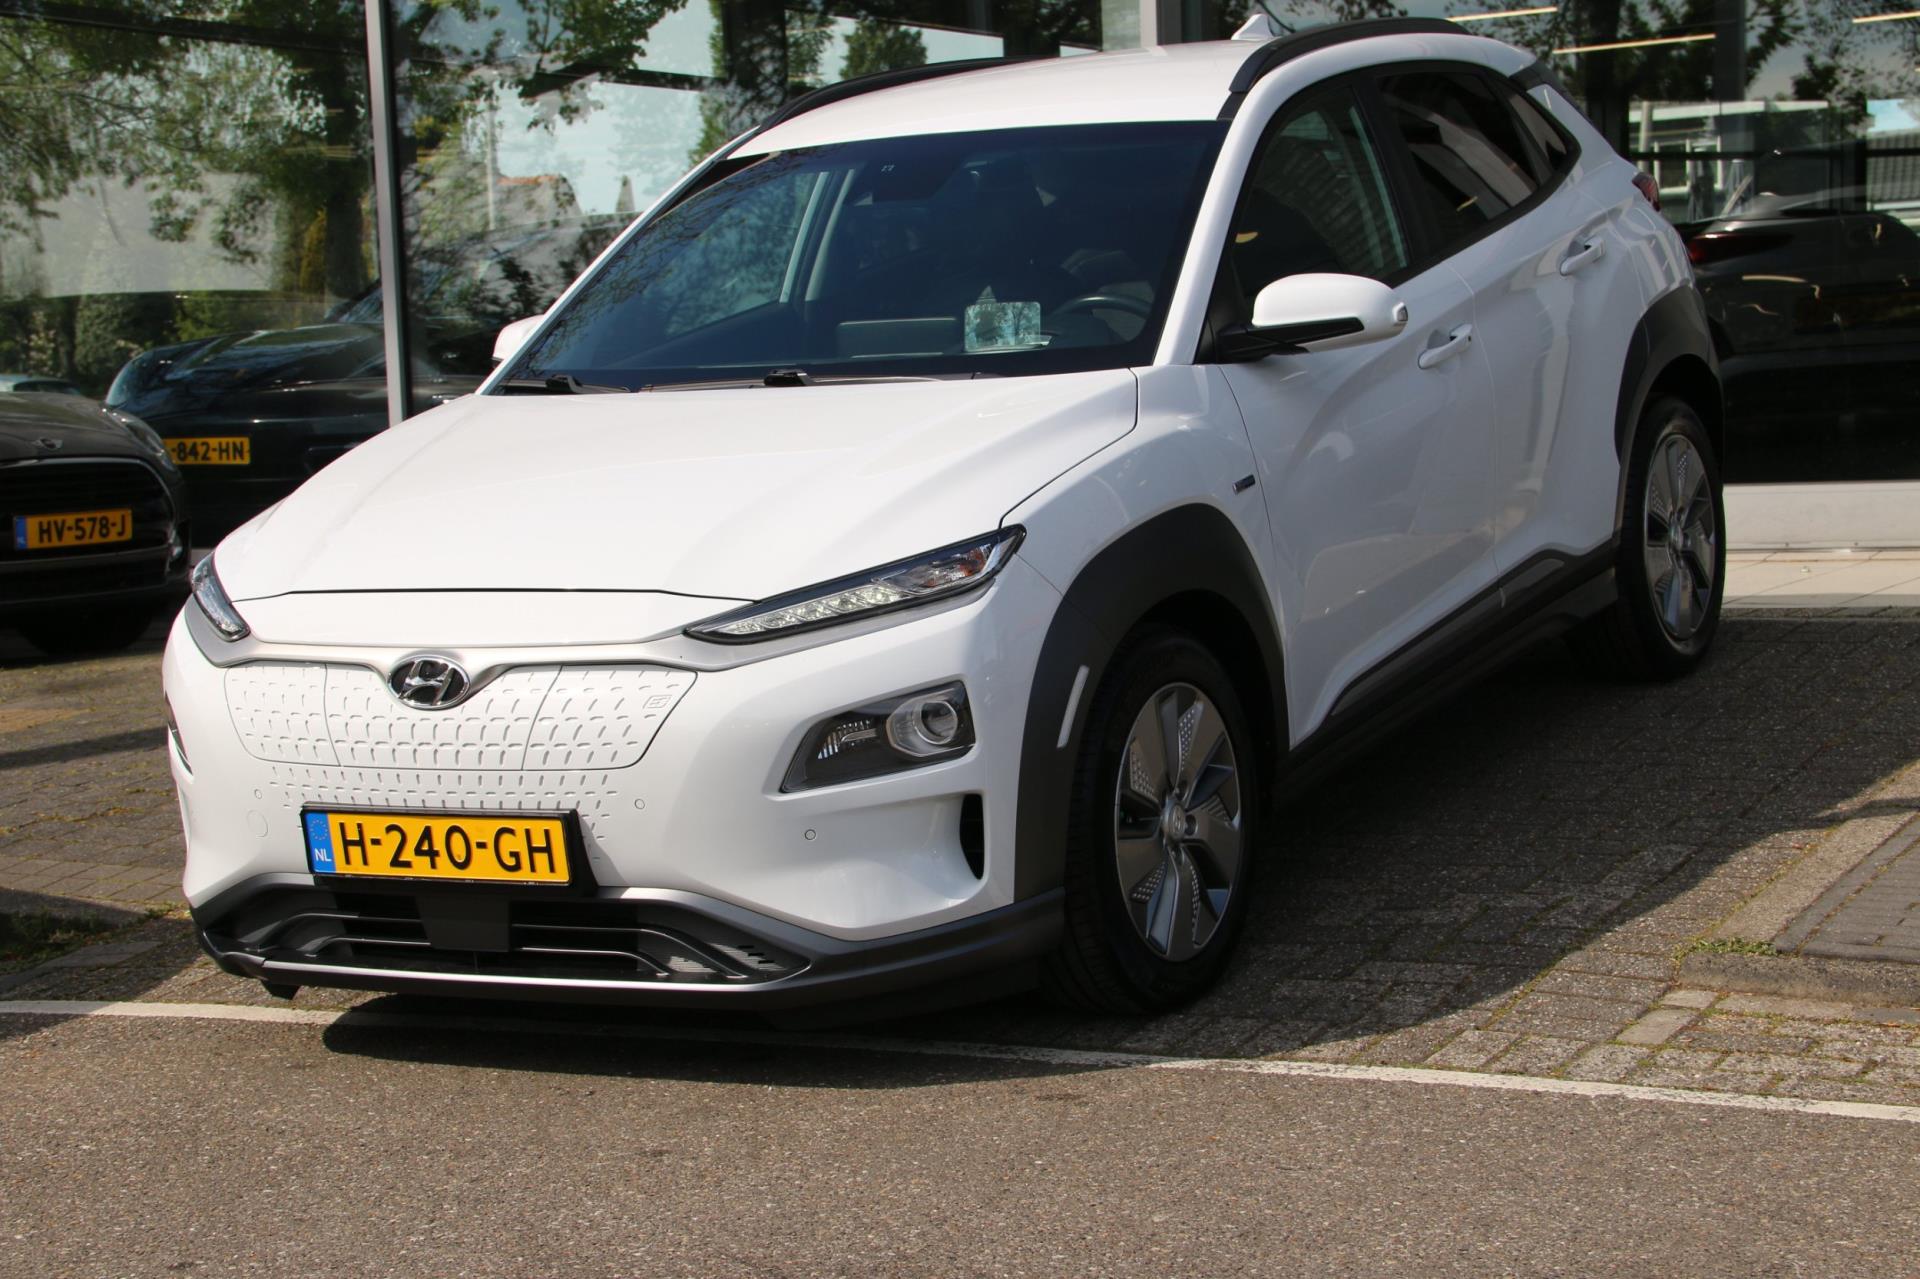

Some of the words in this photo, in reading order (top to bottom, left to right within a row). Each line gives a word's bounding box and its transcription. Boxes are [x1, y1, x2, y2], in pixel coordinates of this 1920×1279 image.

[38, 514, 126, 543] HV-578-J
[314, 848, 331, 862] NL
[338, 822, 556, 874] H-240-GH
